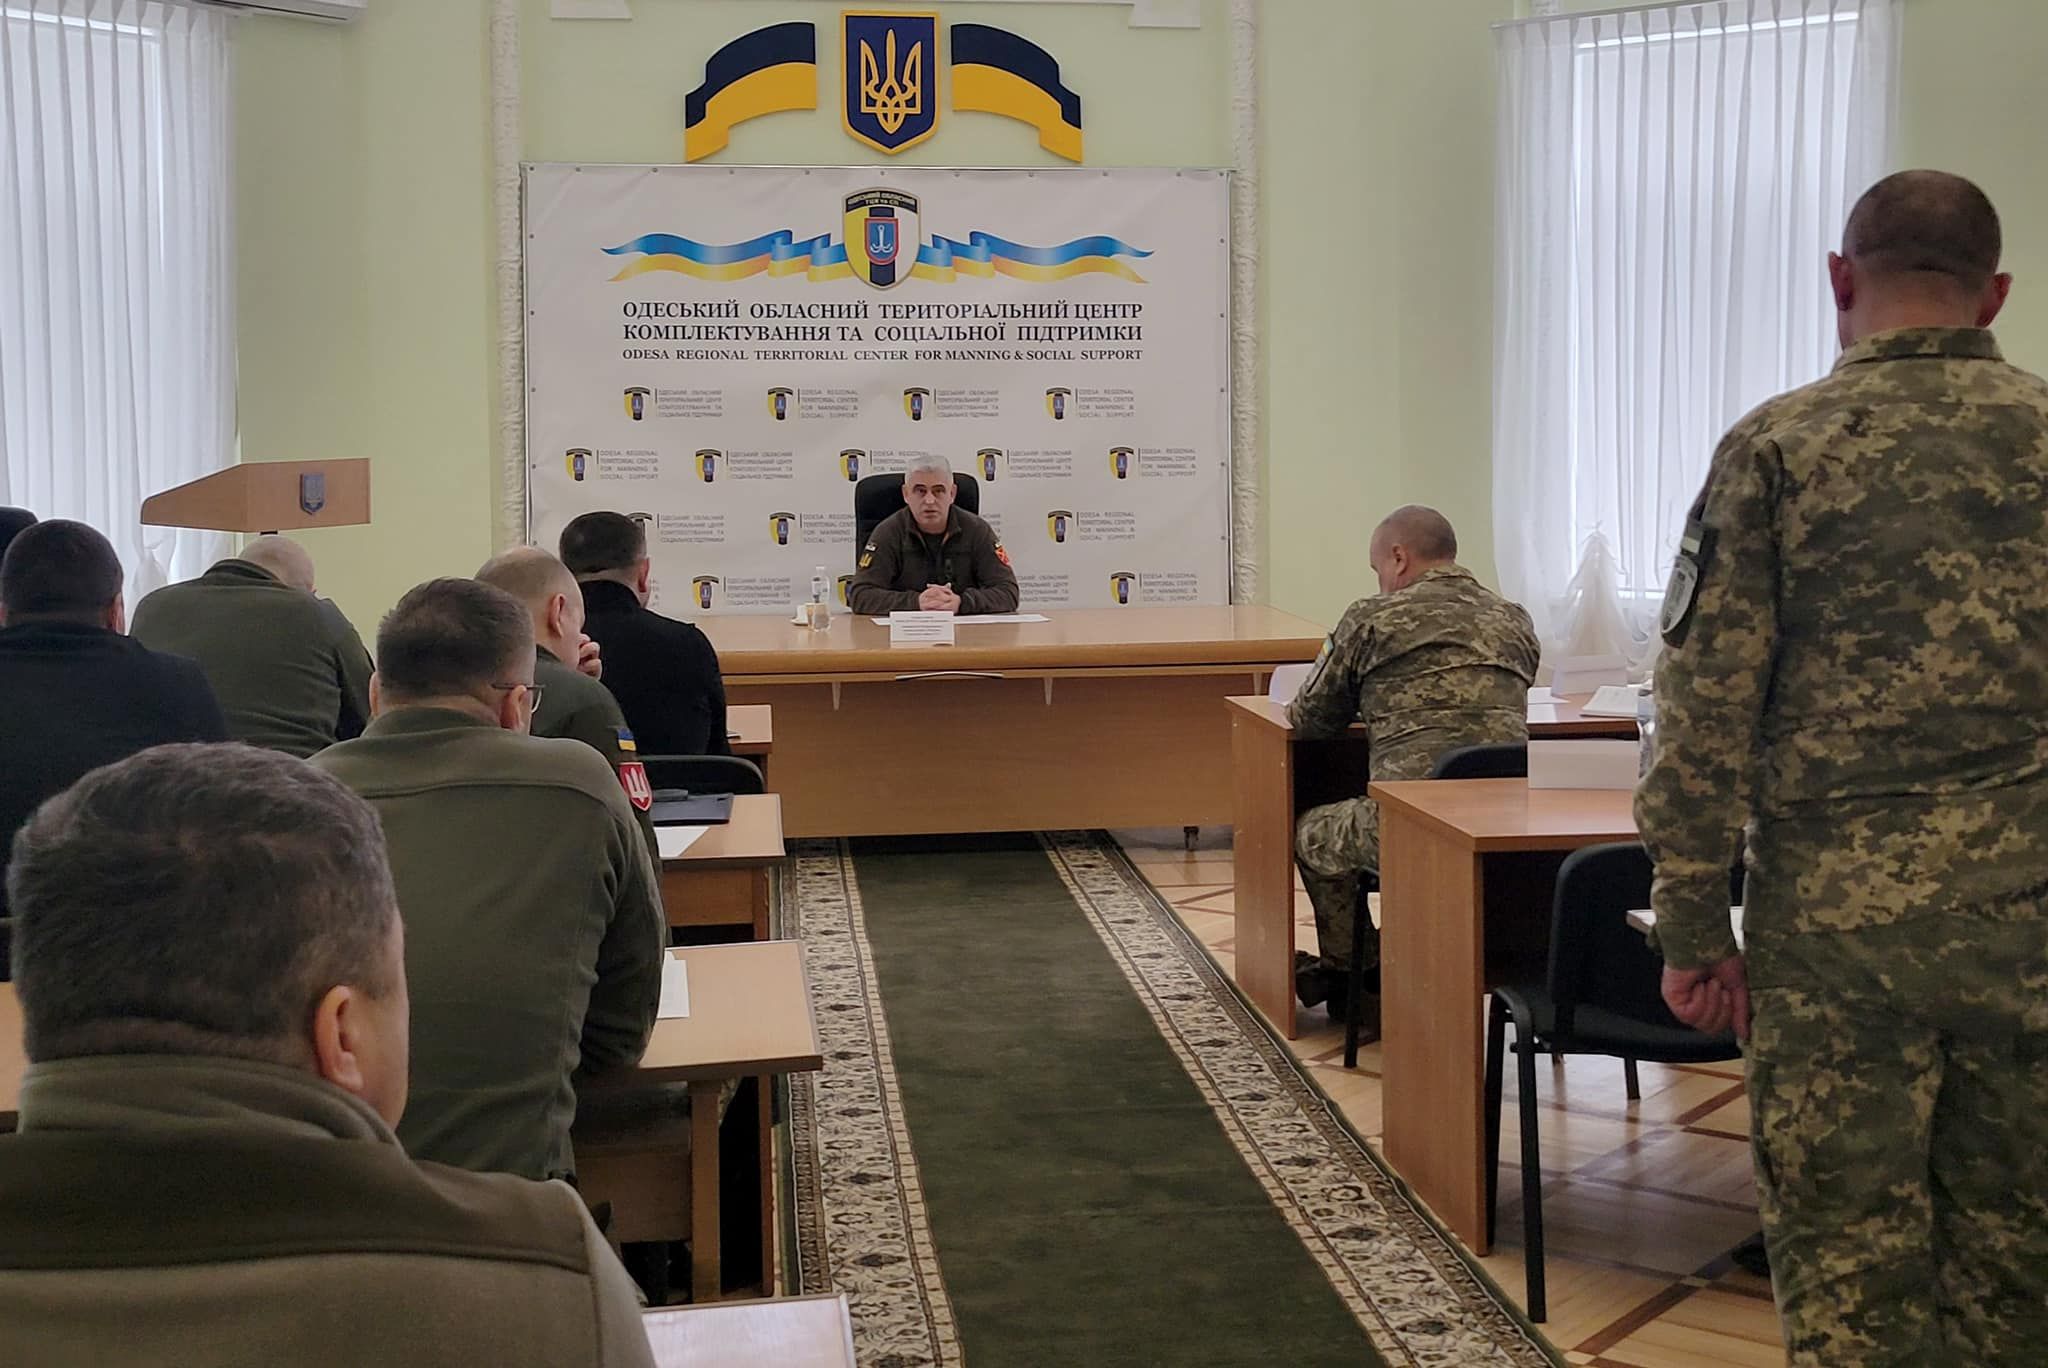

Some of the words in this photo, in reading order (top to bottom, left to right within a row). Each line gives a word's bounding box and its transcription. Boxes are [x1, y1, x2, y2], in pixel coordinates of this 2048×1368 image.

[623, 299, 740, 320] ОДЕСЬКИЙ
[749, 300, 869, 320] ОБЛАСНИЙ
[878, 299, 1069, 320] ТЕРИТОРІАЛЬНИЙ
[1073, 303, 1143, 321] ЦЕНТР
[623, 324, 831, 341] КОМПЛЕКТУВАННЯ
[836, 326, 864, 342] ТА
[873, 322, 1006, 343] СОЦІАЛЬНОЇ
[1017, 325, 1143, 344] ПІДТРИМКИ
[622, 349, 670, 361] ODESA
[676, 349, 749, 361] REGIONAL
[754, 350, 848, 361] TERRITORIAL
[854, 350, 909, 361] CENTER
[915, 350, 942, 361] FOR
[945, 350, 1011, 361] MANNING
[1014, 350, 1024, 361] &
[1026, 350, 1076, 361] SOCIAL
[1080, 350, 1143, 361] SUPPORT
